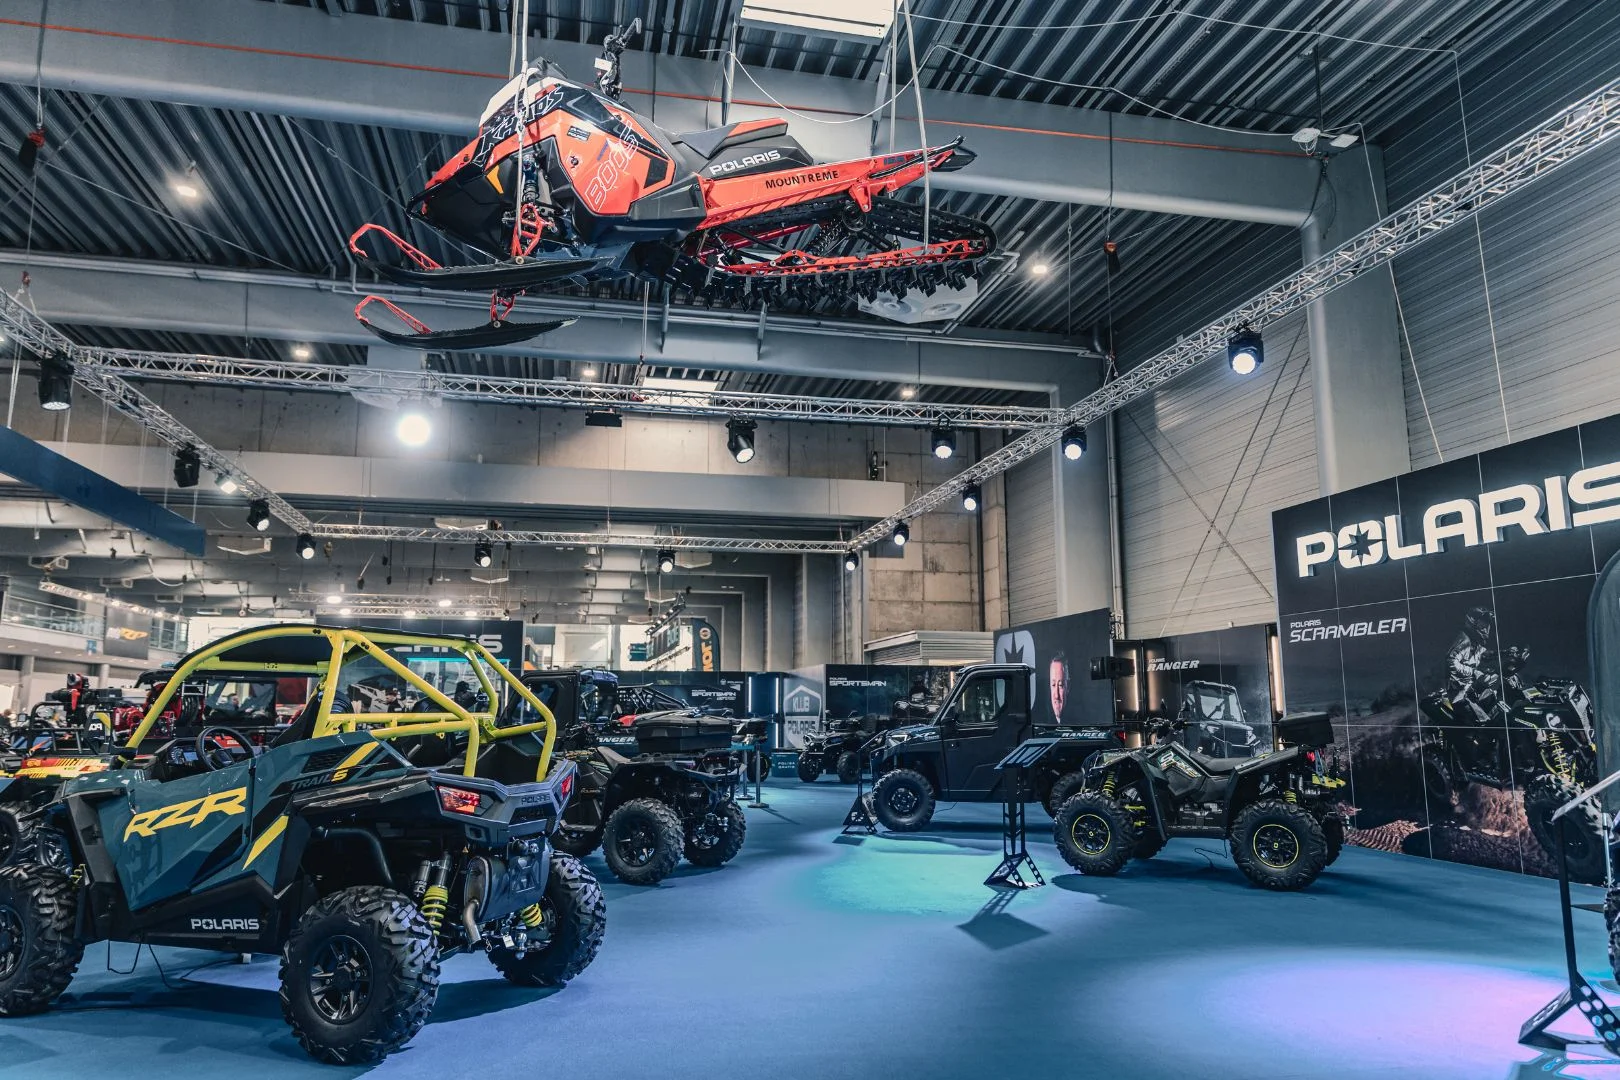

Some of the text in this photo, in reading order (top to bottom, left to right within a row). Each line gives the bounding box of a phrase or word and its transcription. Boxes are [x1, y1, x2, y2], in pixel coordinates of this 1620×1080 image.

[709, 150, 781, 175] POLARIS
[765, 170, 839, 189] MOUNTREME
[1296, 461, 1620, 577] POLARIS
[1289, 617, 1407, 643] SCRAMBLER
[1290, 619, 1322, 628] POLARIS
[1147, 660, 1200, 672] RANGER
[792, 696, 810, 712] KLUB
[123, 786, 247, 843] RZR
[190, 918, 260, 930] POLARIS
